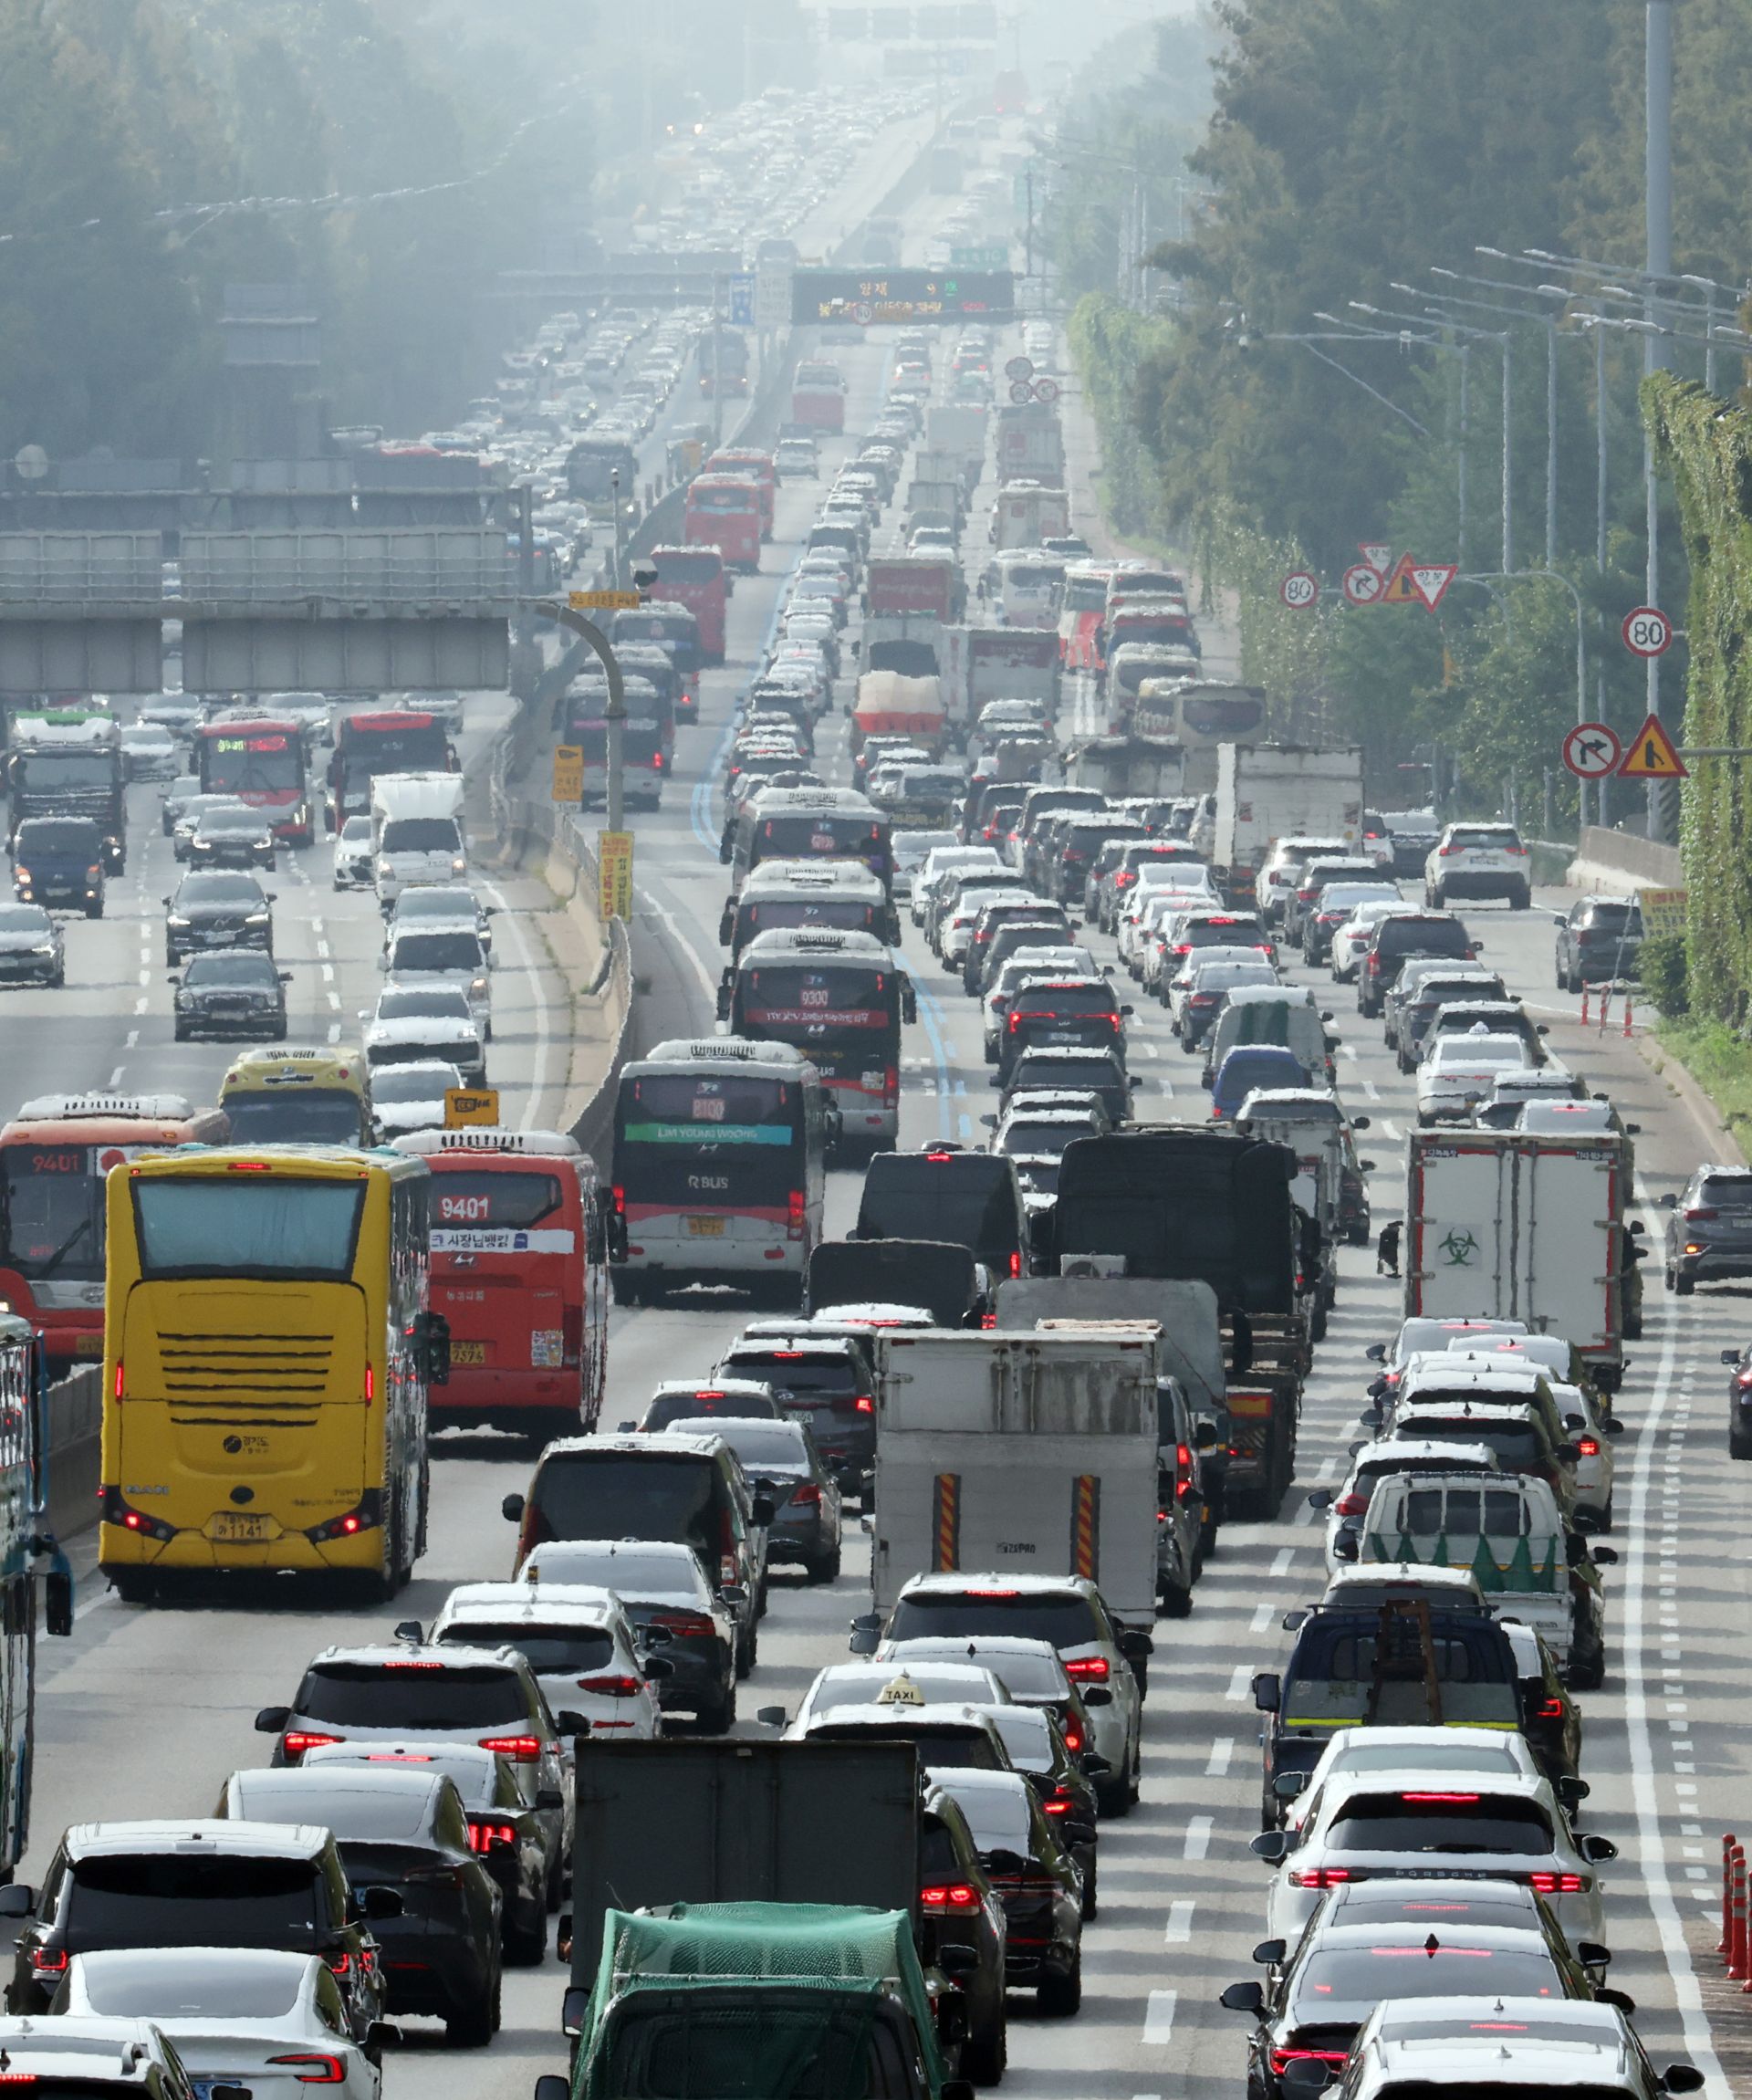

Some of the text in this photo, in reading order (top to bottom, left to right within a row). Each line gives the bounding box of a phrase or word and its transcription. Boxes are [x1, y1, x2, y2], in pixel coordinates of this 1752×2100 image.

[1288, 580, 1312, 601] 80
[1634, 621, 1663, 645] 80
[801, 989, 829, 1006] 9300
[657, 1127, 758, 1139] LIM YOUNG WOONG
[32, 1154, 79, 1173] 9401
[701, 1175, 728, 1189] BUS
[441, 1196, 489, 1219] 9401
[230, 1524, 263, 1539] 1141
[885, 1690, 914, 1700] TAXI
